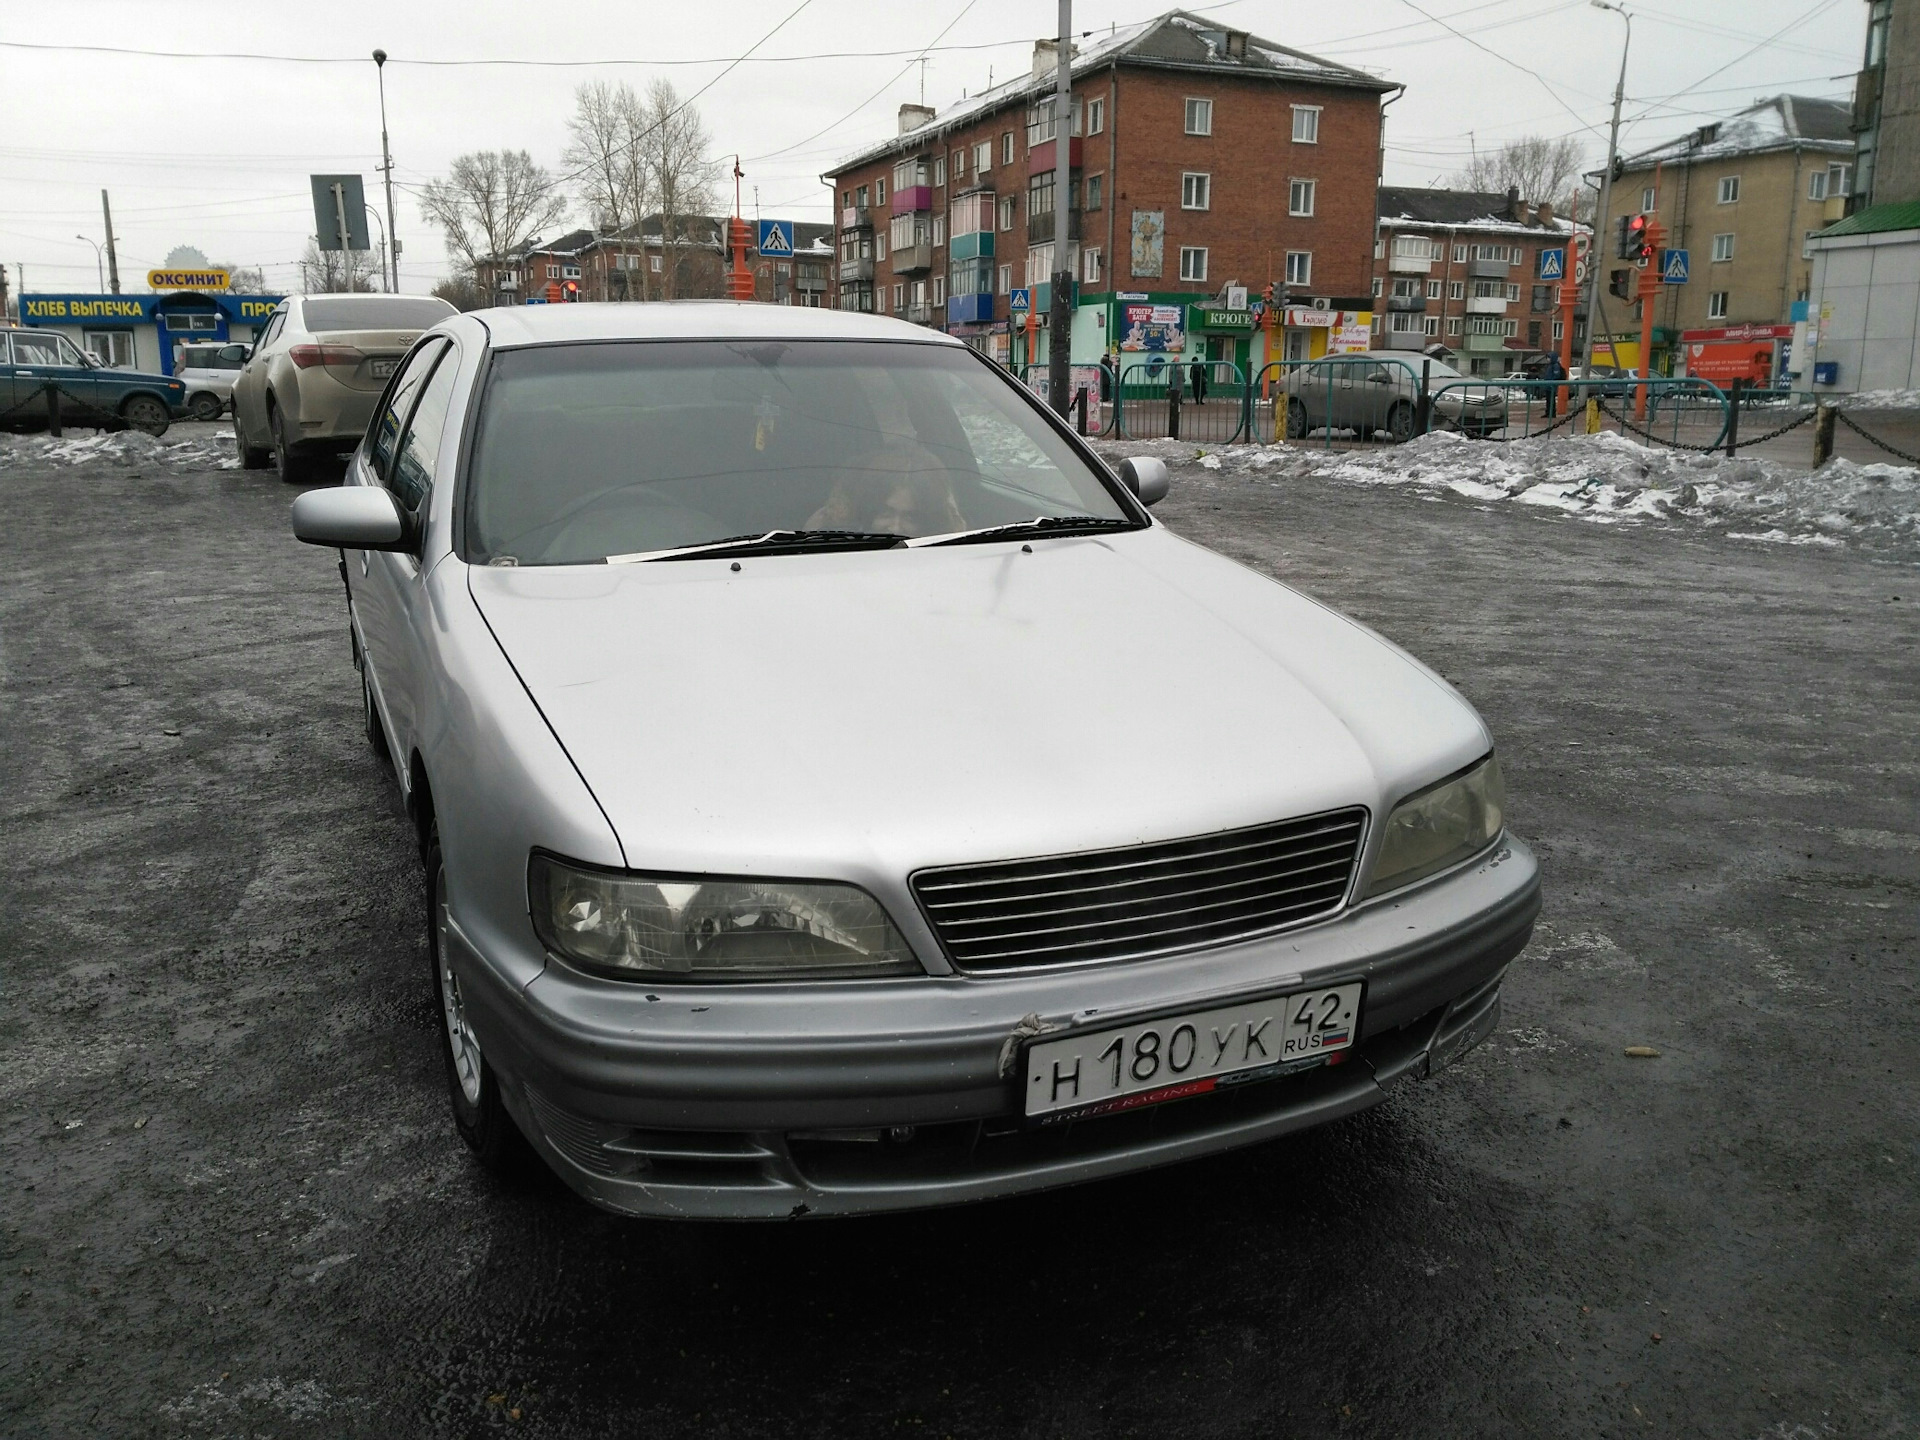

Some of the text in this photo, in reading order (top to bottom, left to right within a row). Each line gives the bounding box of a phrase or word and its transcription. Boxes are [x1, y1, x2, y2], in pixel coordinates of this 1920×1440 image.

[153, 273, 225, 285] ОКСИНИТ
[26, 301, 144, 317] ХЛЕБ ВЫПЕЧКА
[1128, 307, 1152, 315] КРЮГЕР
[1210, 312, 1252, 324] КРЮГЕ
[1293, 991, 1341, 1033] 42
[1284, 1034, 1321, 1054] RUS
[1042, 1084, 1200, 1125] STREET RACING
